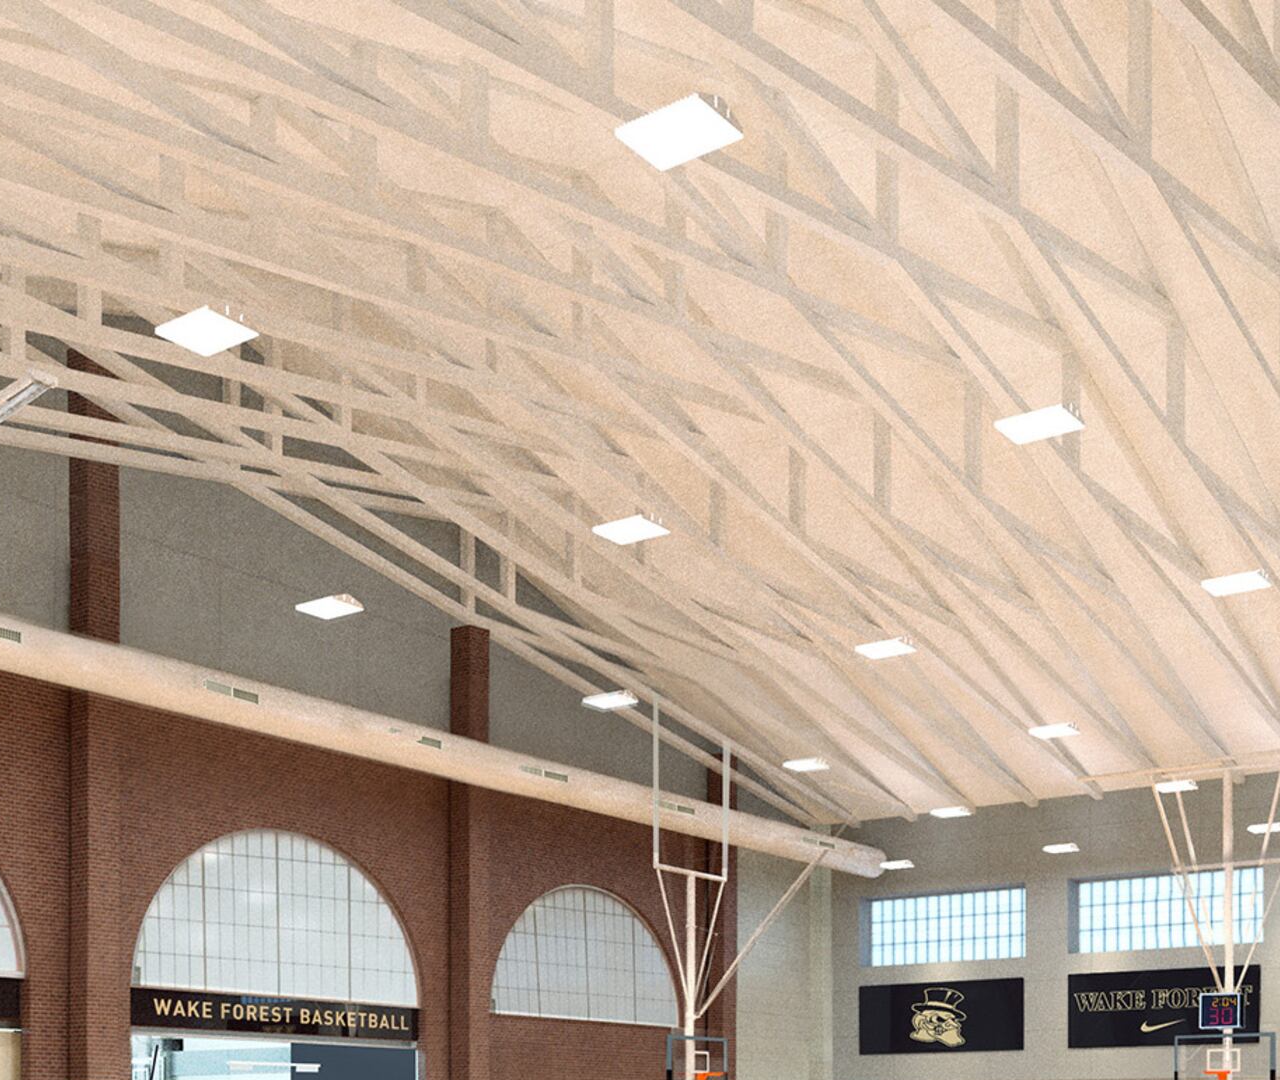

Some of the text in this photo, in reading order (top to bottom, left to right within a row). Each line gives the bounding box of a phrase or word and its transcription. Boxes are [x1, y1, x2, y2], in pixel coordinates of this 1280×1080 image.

[1074, 989, 1146, 1012] WAKE
[154, 998, 409, 1031] WAKE FOREST BASKETBALL
[1209, 1007, 1233, 1025] 30
